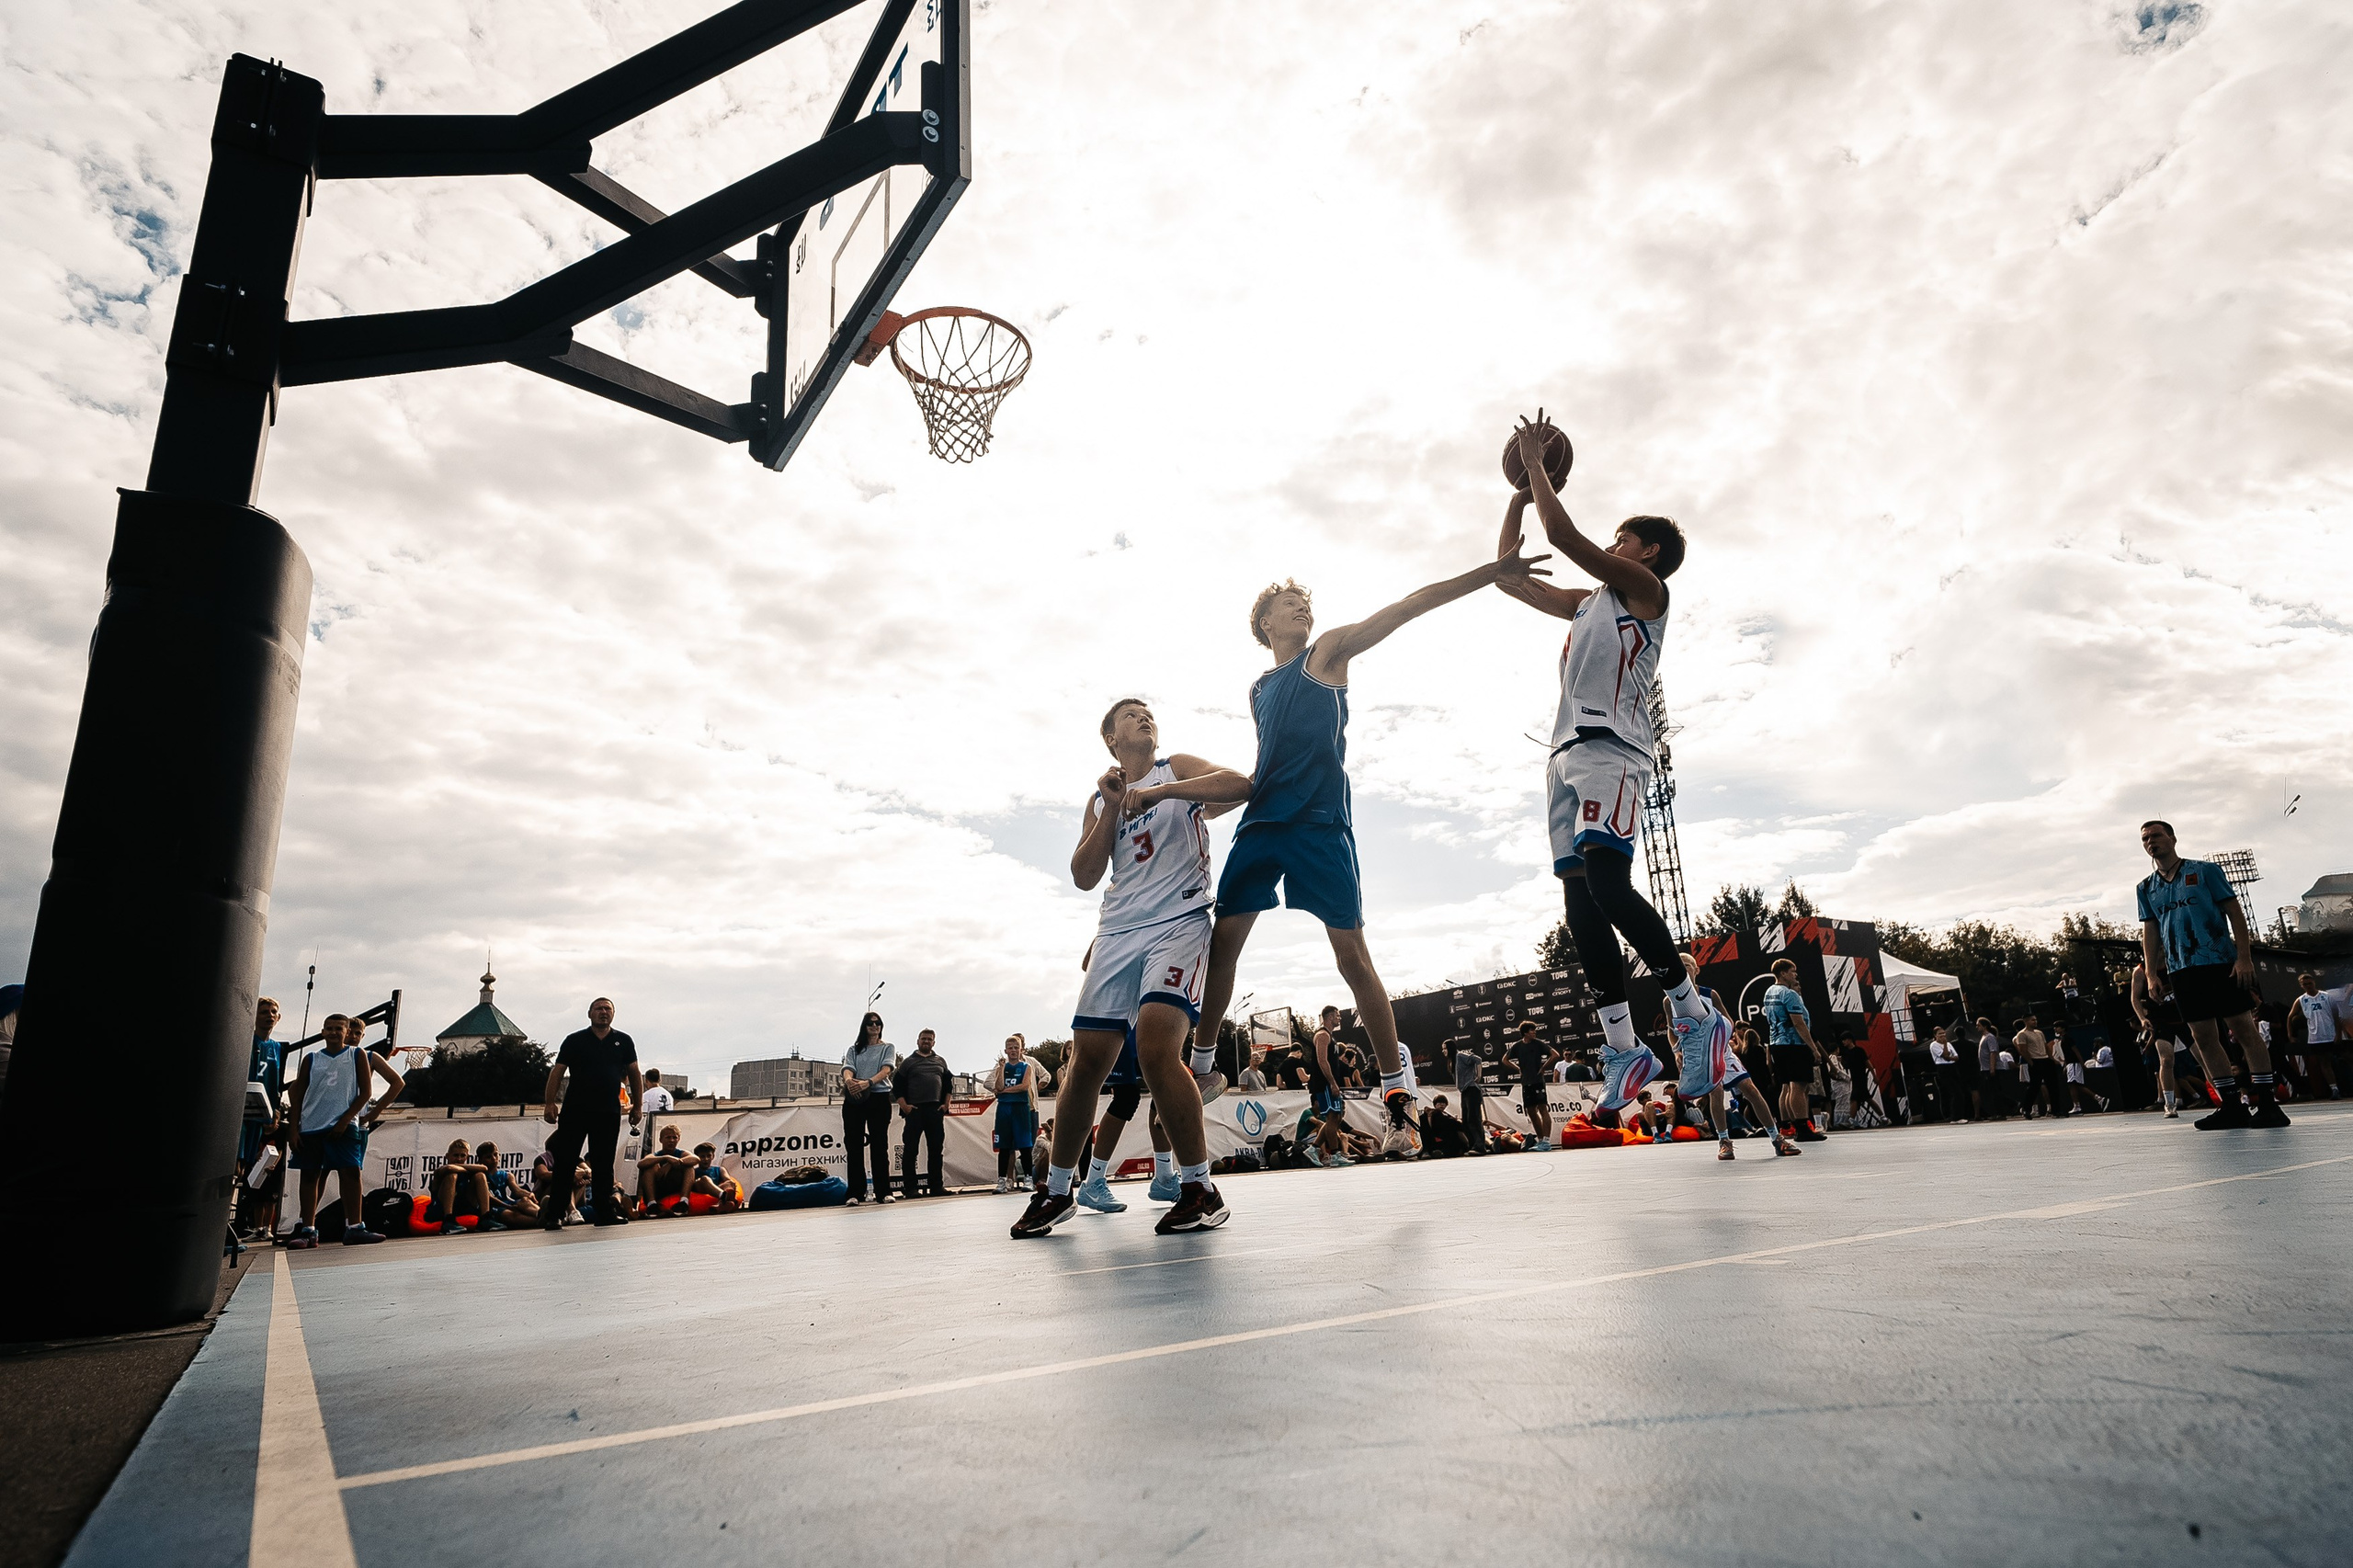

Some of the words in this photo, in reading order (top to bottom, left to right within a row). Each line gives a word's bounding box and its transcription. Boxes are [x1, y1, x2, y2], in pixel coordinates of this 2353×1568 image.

[1583, 800, 1601, 822] 8
[1131, 828, 1154, 864] 3
[1164, 965, 1184, 988] 3
[257, 1061, 267, 1076] 7
[742, 1157, 798, 1169] магазин
[801, 1153, 847, 1166] техник
